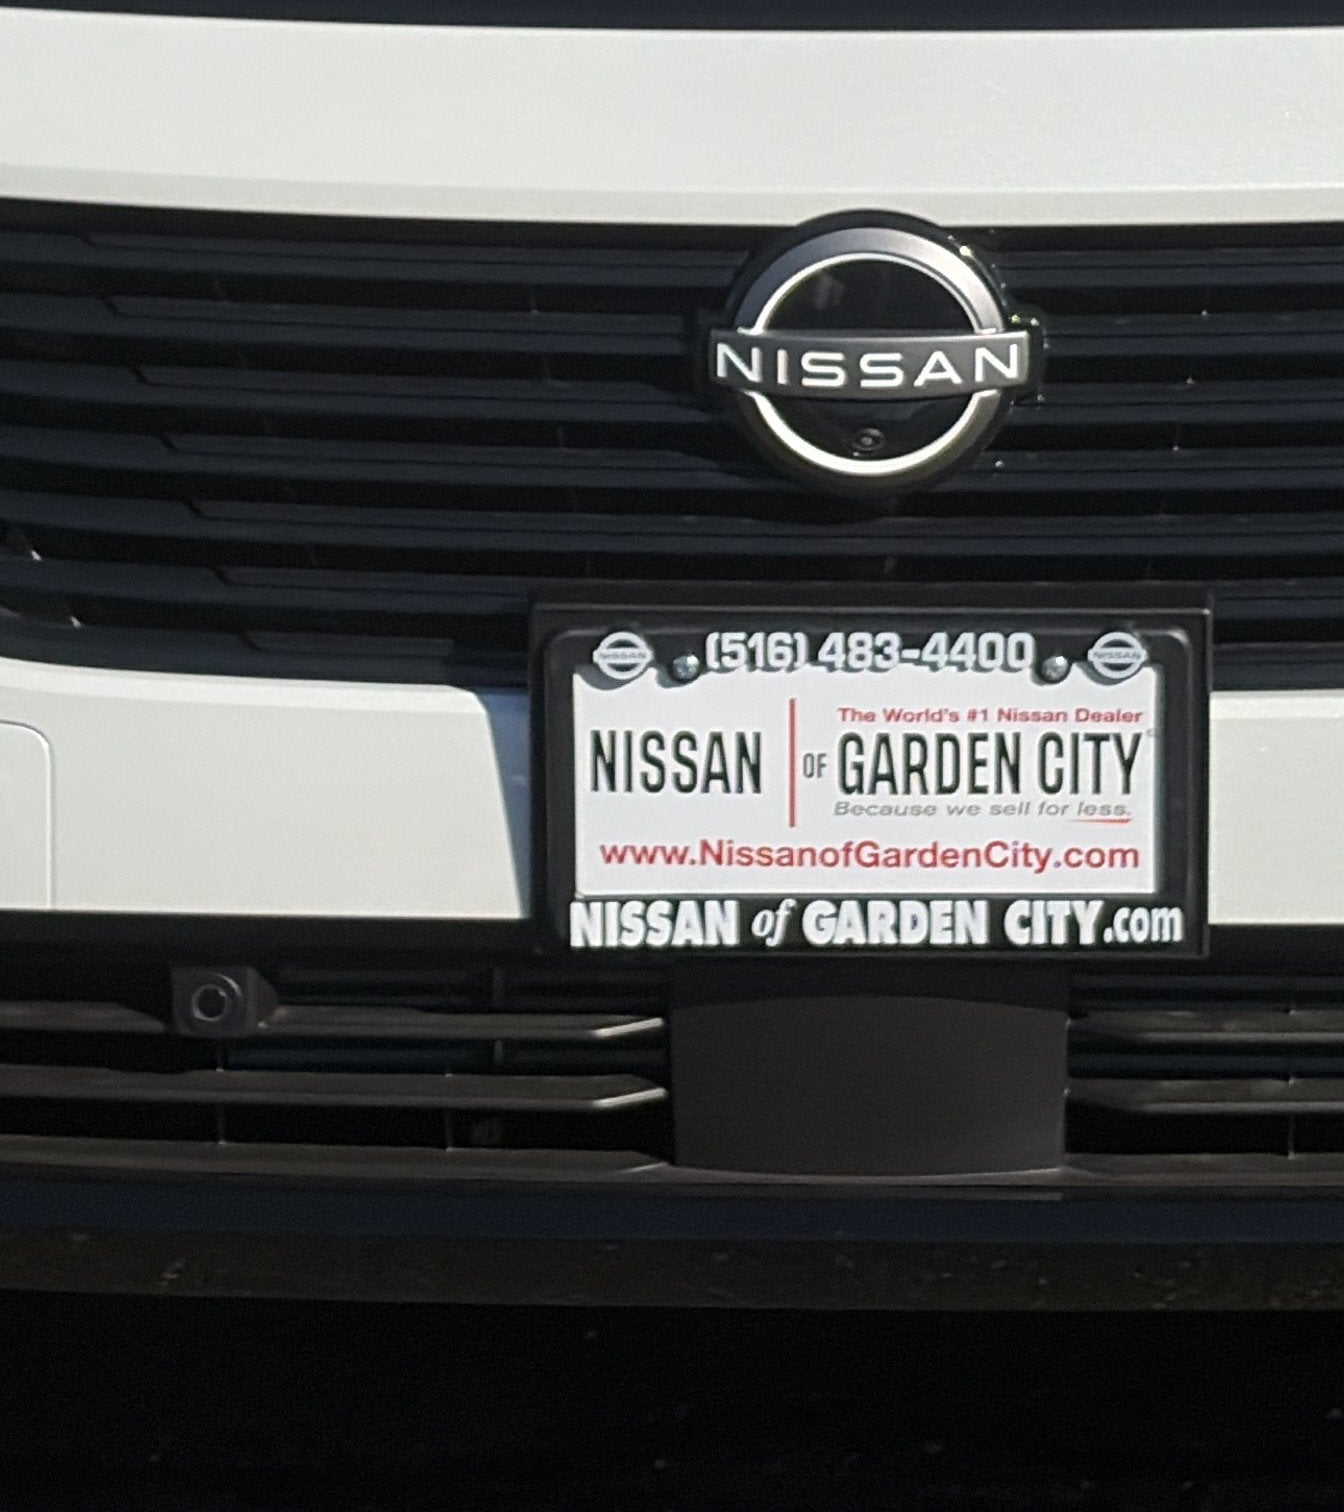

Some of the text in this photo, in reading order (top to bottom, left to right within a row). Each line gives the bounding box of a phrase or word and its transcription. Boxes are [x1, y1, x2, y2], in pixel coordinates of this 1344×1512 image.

[716, 342, 1019, 388] NISSAN
[706, 631, 1036, 671] (516) 483-4400
[837, 708, 1143, 723] The World's #1 Nissan Dealer
[590, 729, 1143, 796] NISSAN OF GARDEN CITY
[833, 800, 1132, 817] Because we sell for less.
[600, 839, 1140, 874] www.NissanofGardenCity.com
[570, 898, 1183, 947] NISSAN of GARDEN CITY.com
